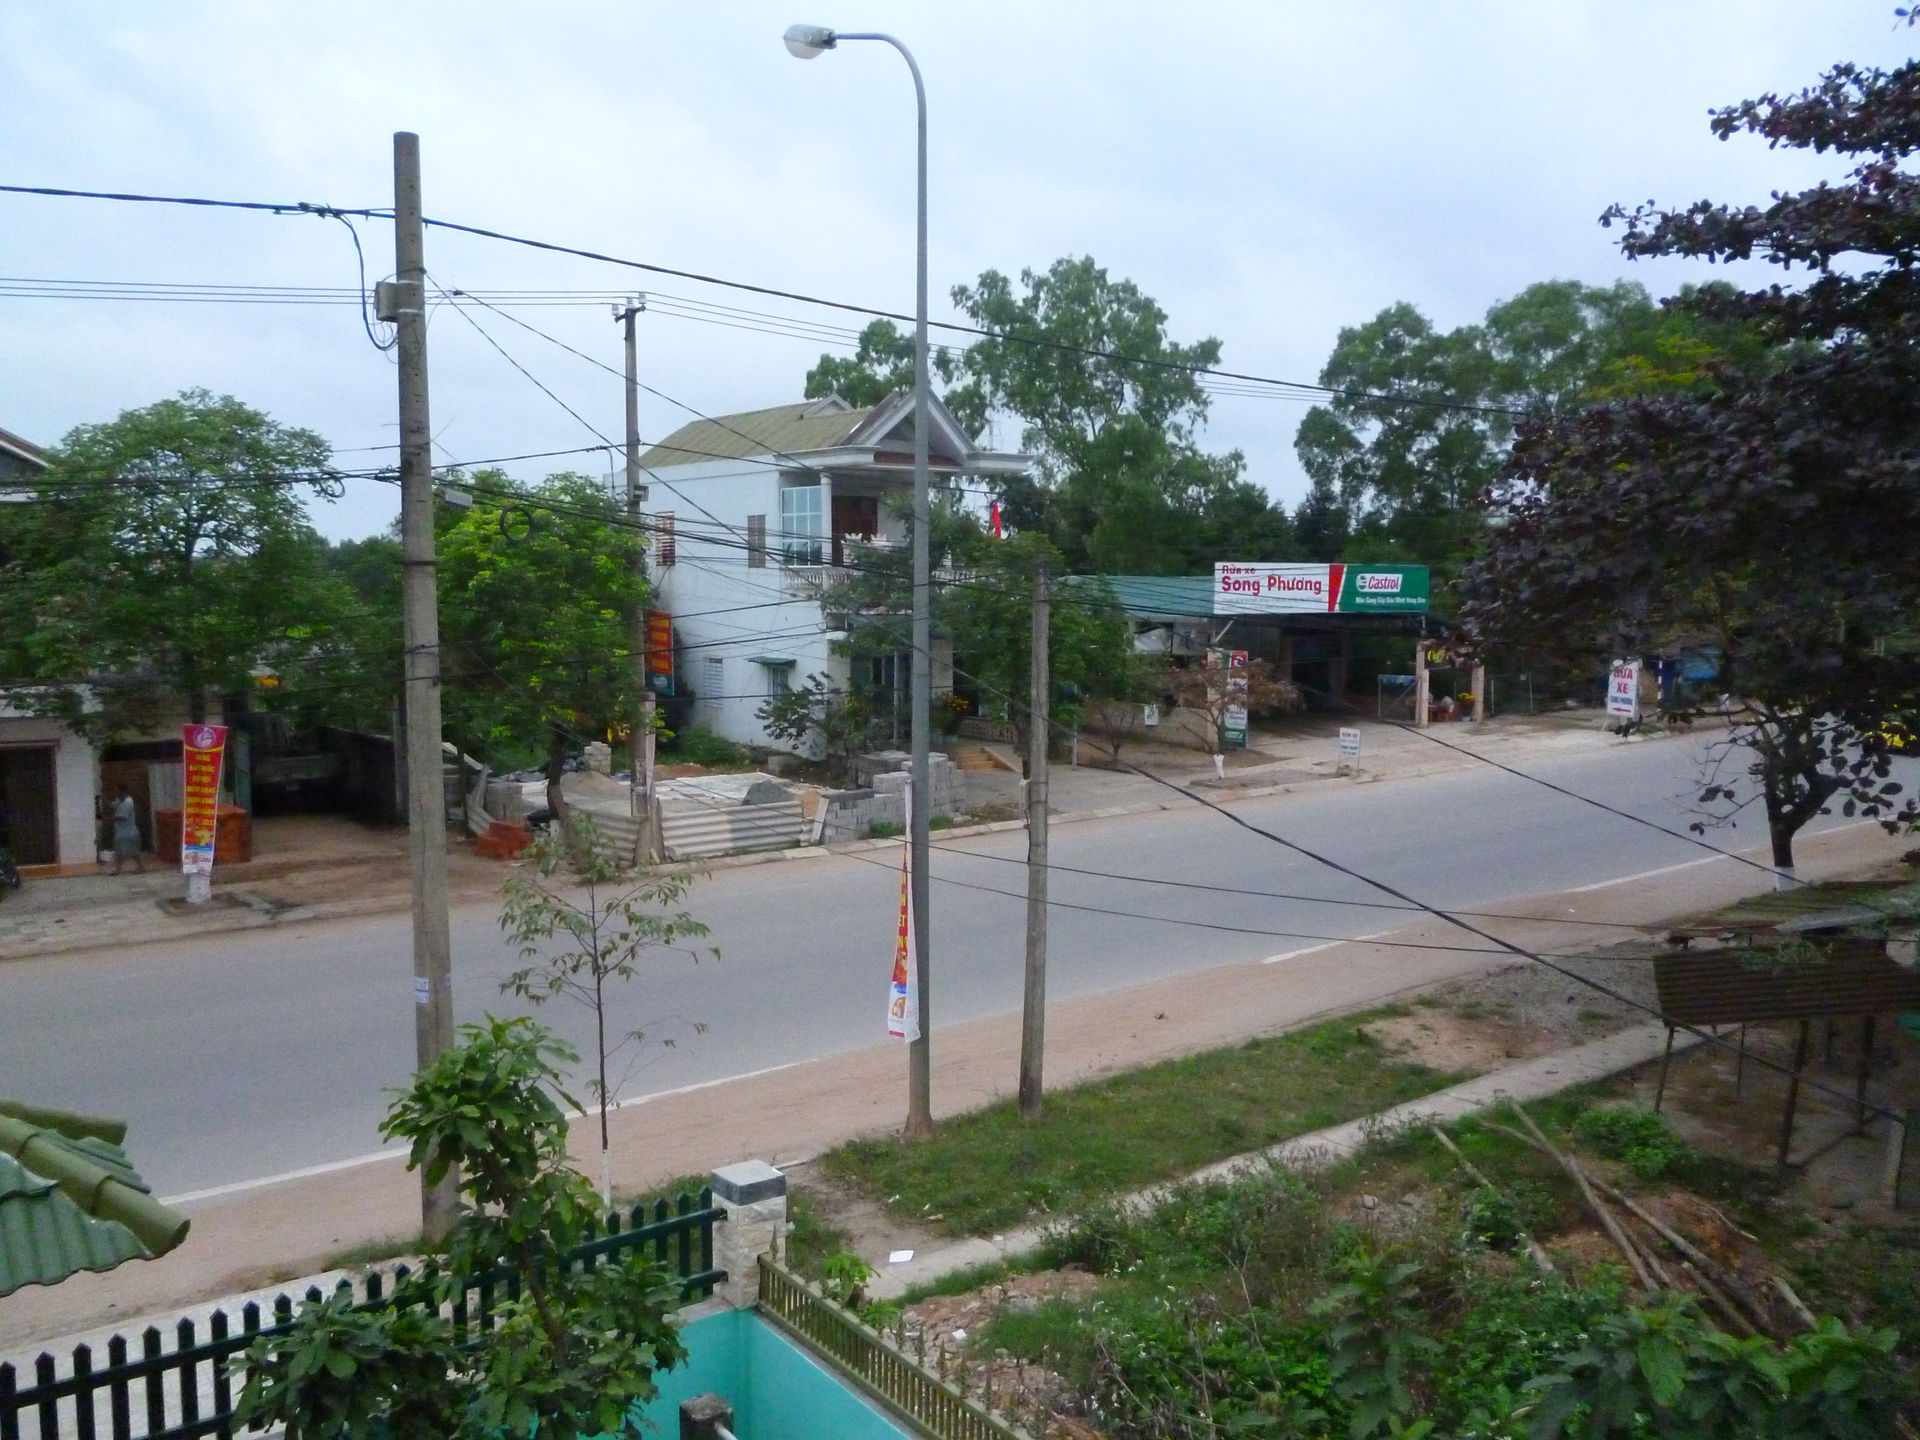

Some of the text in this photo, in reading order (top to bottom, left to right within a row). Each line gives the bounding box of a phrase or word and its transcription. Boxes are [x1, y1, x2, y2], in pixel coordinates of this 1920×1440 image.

[1221, 575, 1322, 596] Song Phương
[1368, 576, 1400, 590] Castrol
[1617, 682, 1629, 694] XE
